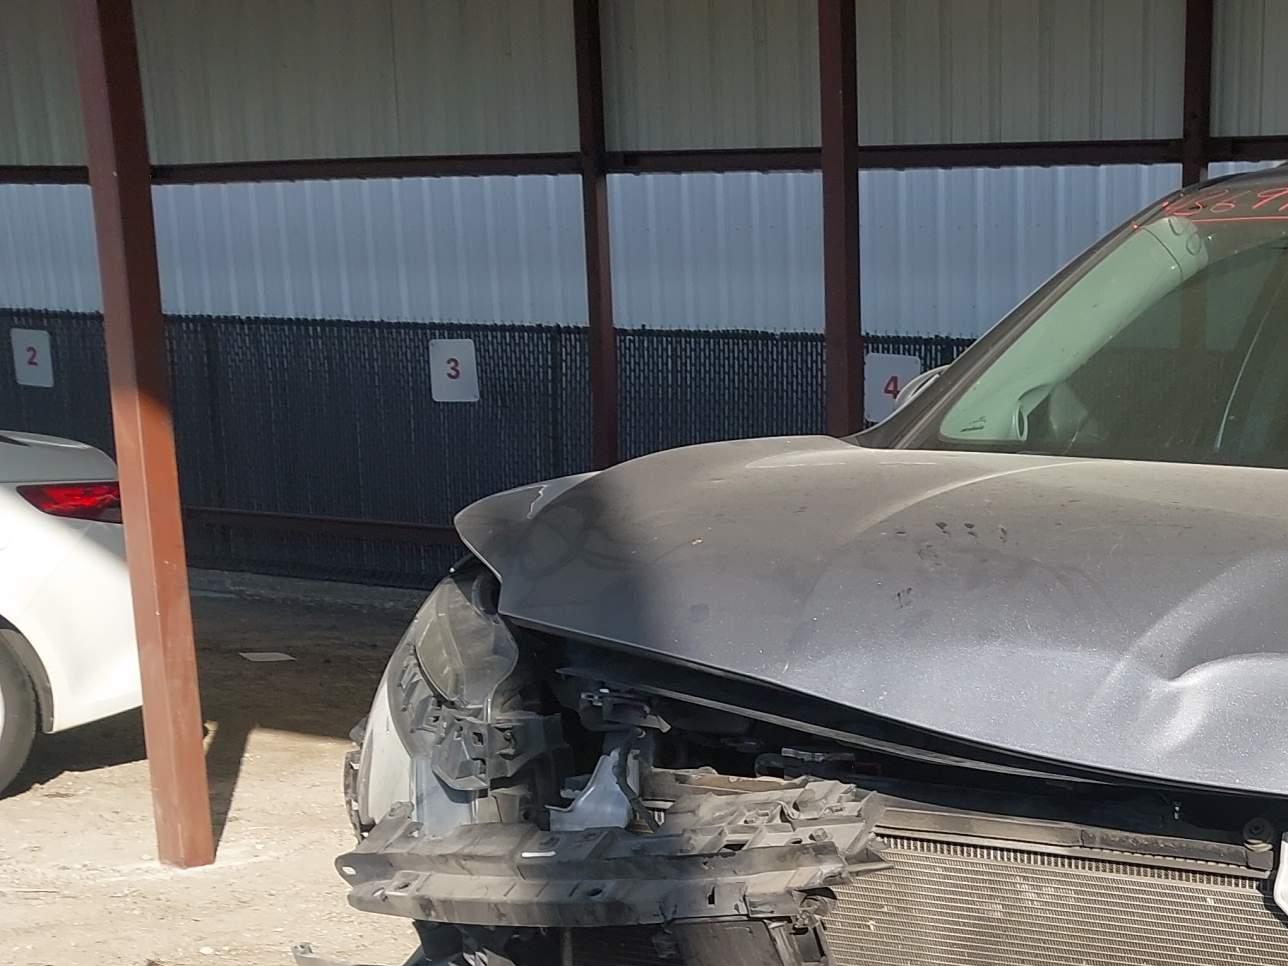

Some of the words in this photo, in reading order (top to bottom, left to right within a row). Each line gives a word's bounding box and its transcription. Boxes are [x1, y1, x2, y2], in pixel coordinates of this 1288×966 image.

[26, 346, 39, 366] 2
[446, 358, 460, 380] 3
[884, 375, 901, 400] 4
